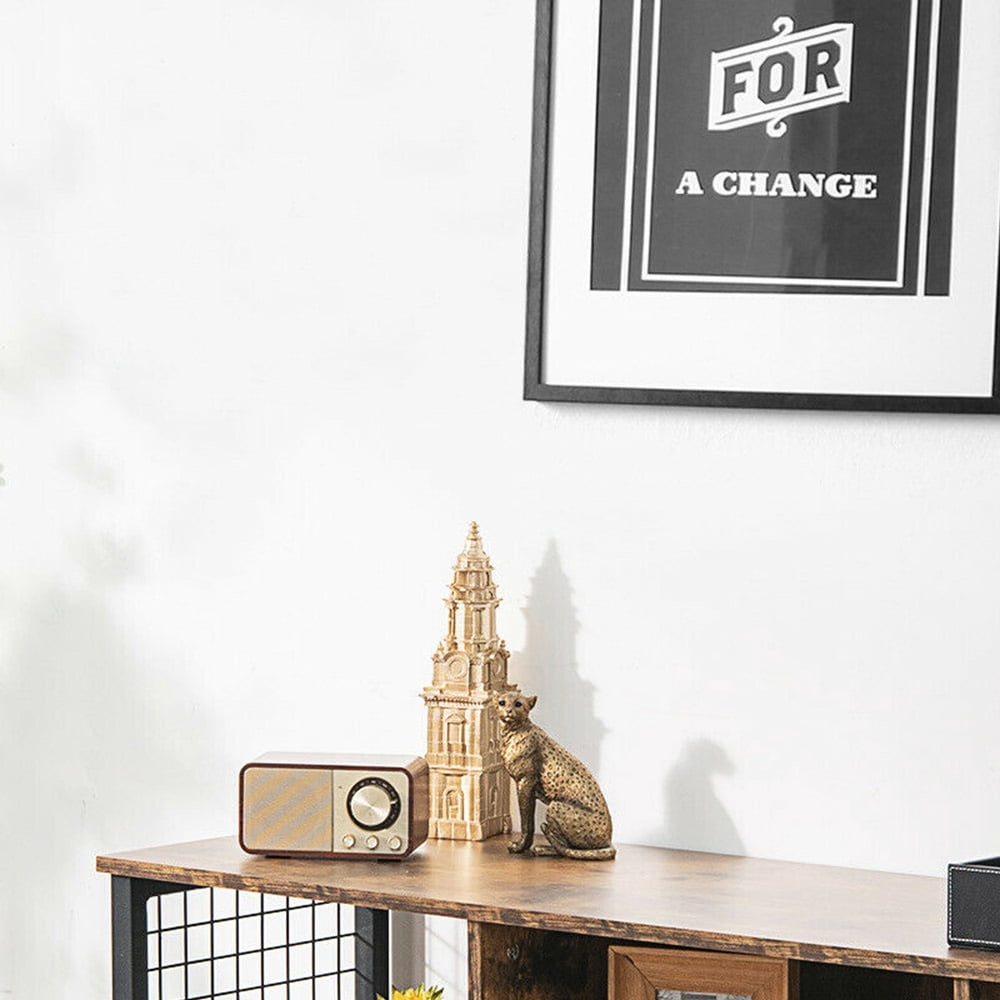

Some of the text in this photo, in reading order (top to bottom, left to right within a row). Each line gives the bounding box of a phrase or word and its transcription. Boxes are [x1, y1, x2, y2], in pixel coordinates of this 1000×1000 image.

[721, 39, 841, 116] FOR
[675, 171, 878, 199] A CHANGE
